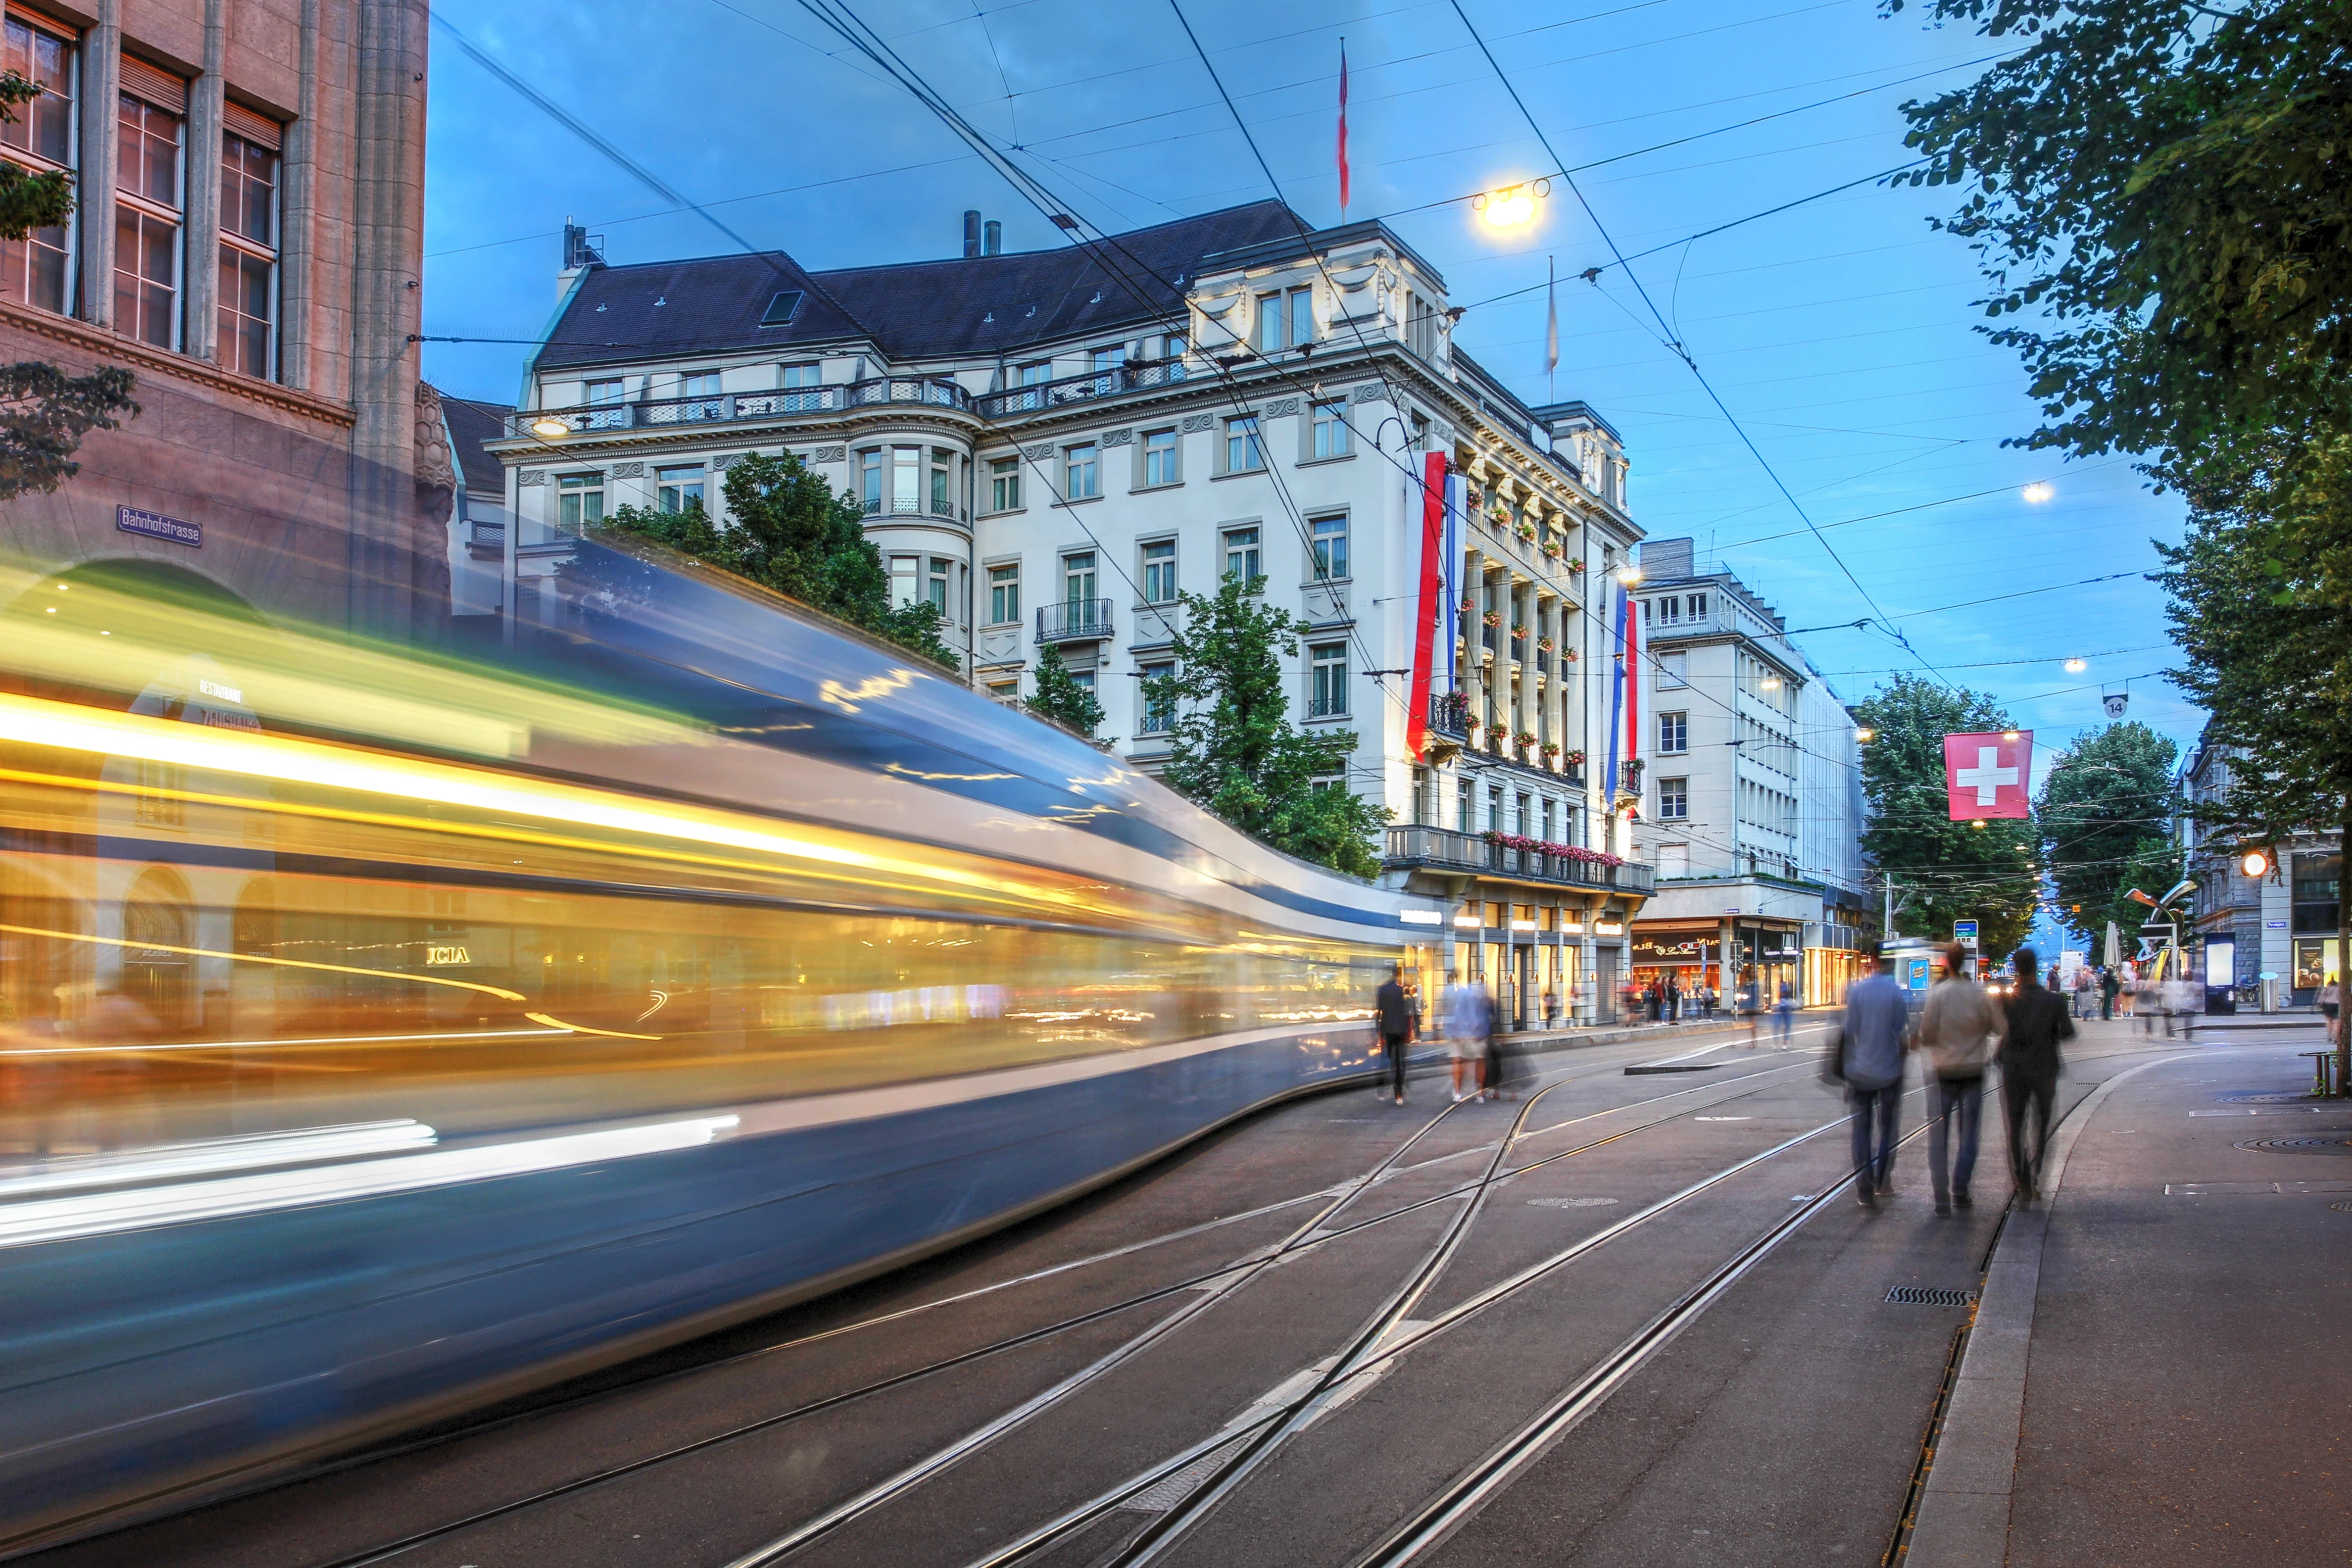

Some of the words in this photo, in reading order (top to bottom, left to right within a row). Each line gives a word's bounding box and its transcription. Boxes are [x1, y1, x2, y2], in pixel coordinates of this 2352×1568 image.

[122, 509, 199, 541] Bahnhofstrasse
[200, 679, 242, 704] RESTAURANT
[2109, 703, 2123, 713] 14
